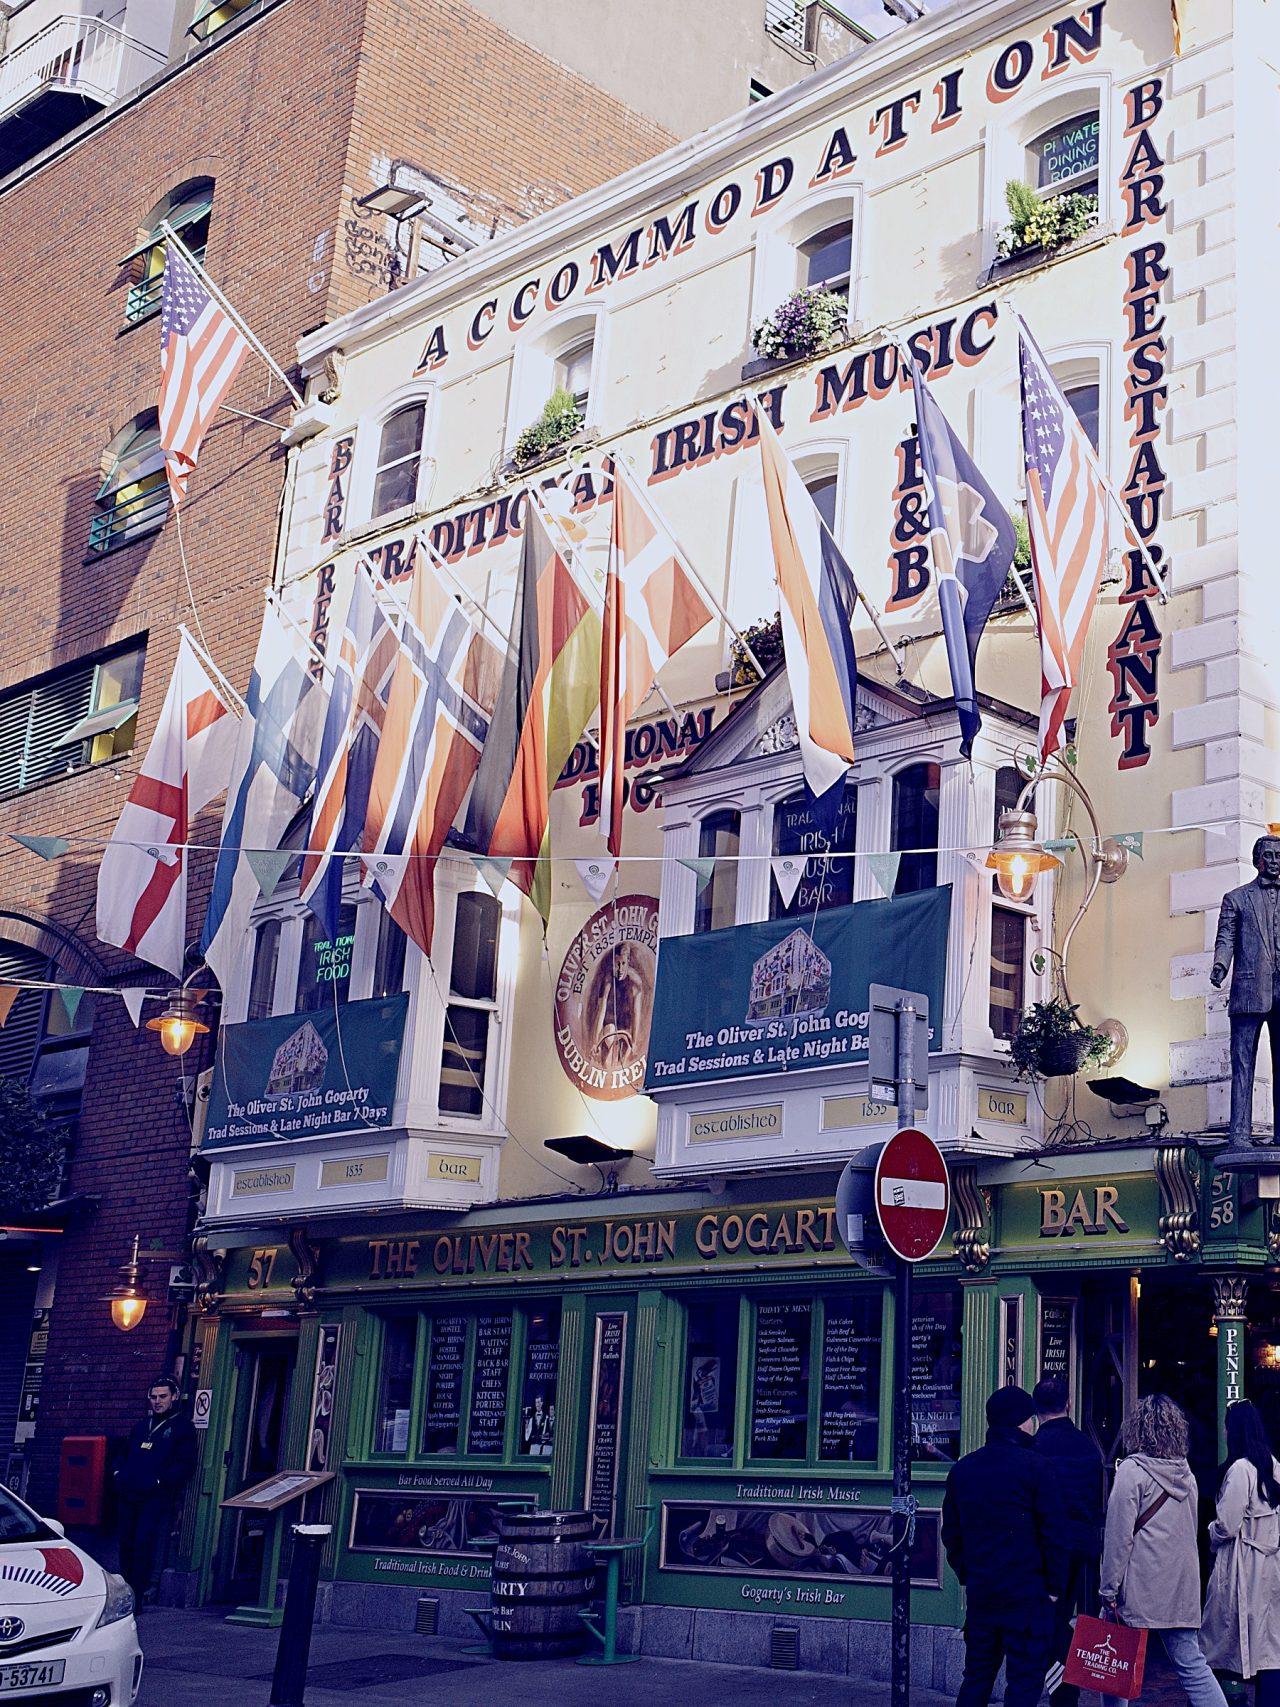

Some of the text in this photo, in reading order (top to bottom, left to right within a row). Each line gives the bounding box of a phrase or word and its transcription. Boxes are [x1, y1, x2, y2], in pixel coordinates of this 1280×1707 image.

[1048, 139, 1096, 170] DINING
[413, 4, 1102, 377] ACCOMMODATION
[810, 301, 999, 423] MUSIC
[1106, 78, 1170, 770] BAR RESTAURANT
[321, 437, 353, 544] BAR
[557, 934, 592, 1003] OLIVER
[591, 914, 608, 941] ST
[612, 906, 649, 930] JOHN
[573, 932, 614, 994] EST 1835
[317, 964, 349, 983] FOOD
[686, 1015, 830, 1050] The Oliver St. John
[558, 1025, 608, 1089] DUBLIN
[654, 1037, 848, 1077] Trad Sessions & Late Night
[227, 1087, 369, 1118] The Oliver St. John Gogarty
[208, 1127, 227, 1140] Trad
[229, 1121, 270, 1138] Sessions
[271, 1120, 278, 1132] &
[280, 1117, 301, 1131] Late
[303, 1112, 332, 1130] Night
[334, 1109, 351, 1123] Bar
[362, 1106, 387, 1121] Days
[694, 1096, 1015, 1136] established bar
[236, 1159, 467, 1190] established 1835 bar
[1211, 1172, 1233, 1196] 57
[1039, 1187, 1130, 1238] BAR
[1210, 1201, 1234, 1229] 58
[368, 1206, 837, 1280] THE OLIVER ST. JOHN GOGART
[248, 1249, 277, 1289] 57
[480, 1338, 509, 1347] WAITING
[484, 1347, 503, 1356] STAFF
[1049, 1337, 1062, 1345] Live
[477, 1359, 495, 1367] BACK
[1045, 1349, 1065, 1358] IRISH
[482, 1368, 501, 1377] STAFF
[1043, 1362, 1067, 1371] MUSIC
[1226, 1329, 1240, 1407] PENTH
[481, 1379, 501, 1388] CHEFS
[476, 1391, 505, 1400] KITCHEN
[476, 1400, 504, 1409] PORTERS
[479, 1418, 499, 1427] STAFF
[927, 1412, 954, 1420] NIGHT
[922, 1423, 937, 1432] BAR
[399, 1473, 493, 1490] Bar Food Served All Day
[736, 1484, 861, 1501] Traditional Irish Music
[374, 1558, 468, 1576] Traditional Irish Food &
[511, 1549, 531, 1564] JOHN
[741, 1584, 845, 1604] Gogarty's Irish Bar
[501, 1606, 514, 1615] Bar
[1076, 1649, 1129, 1671] TEMPLE BAR
[1084, 1660, 1107, 1671] TRADING
